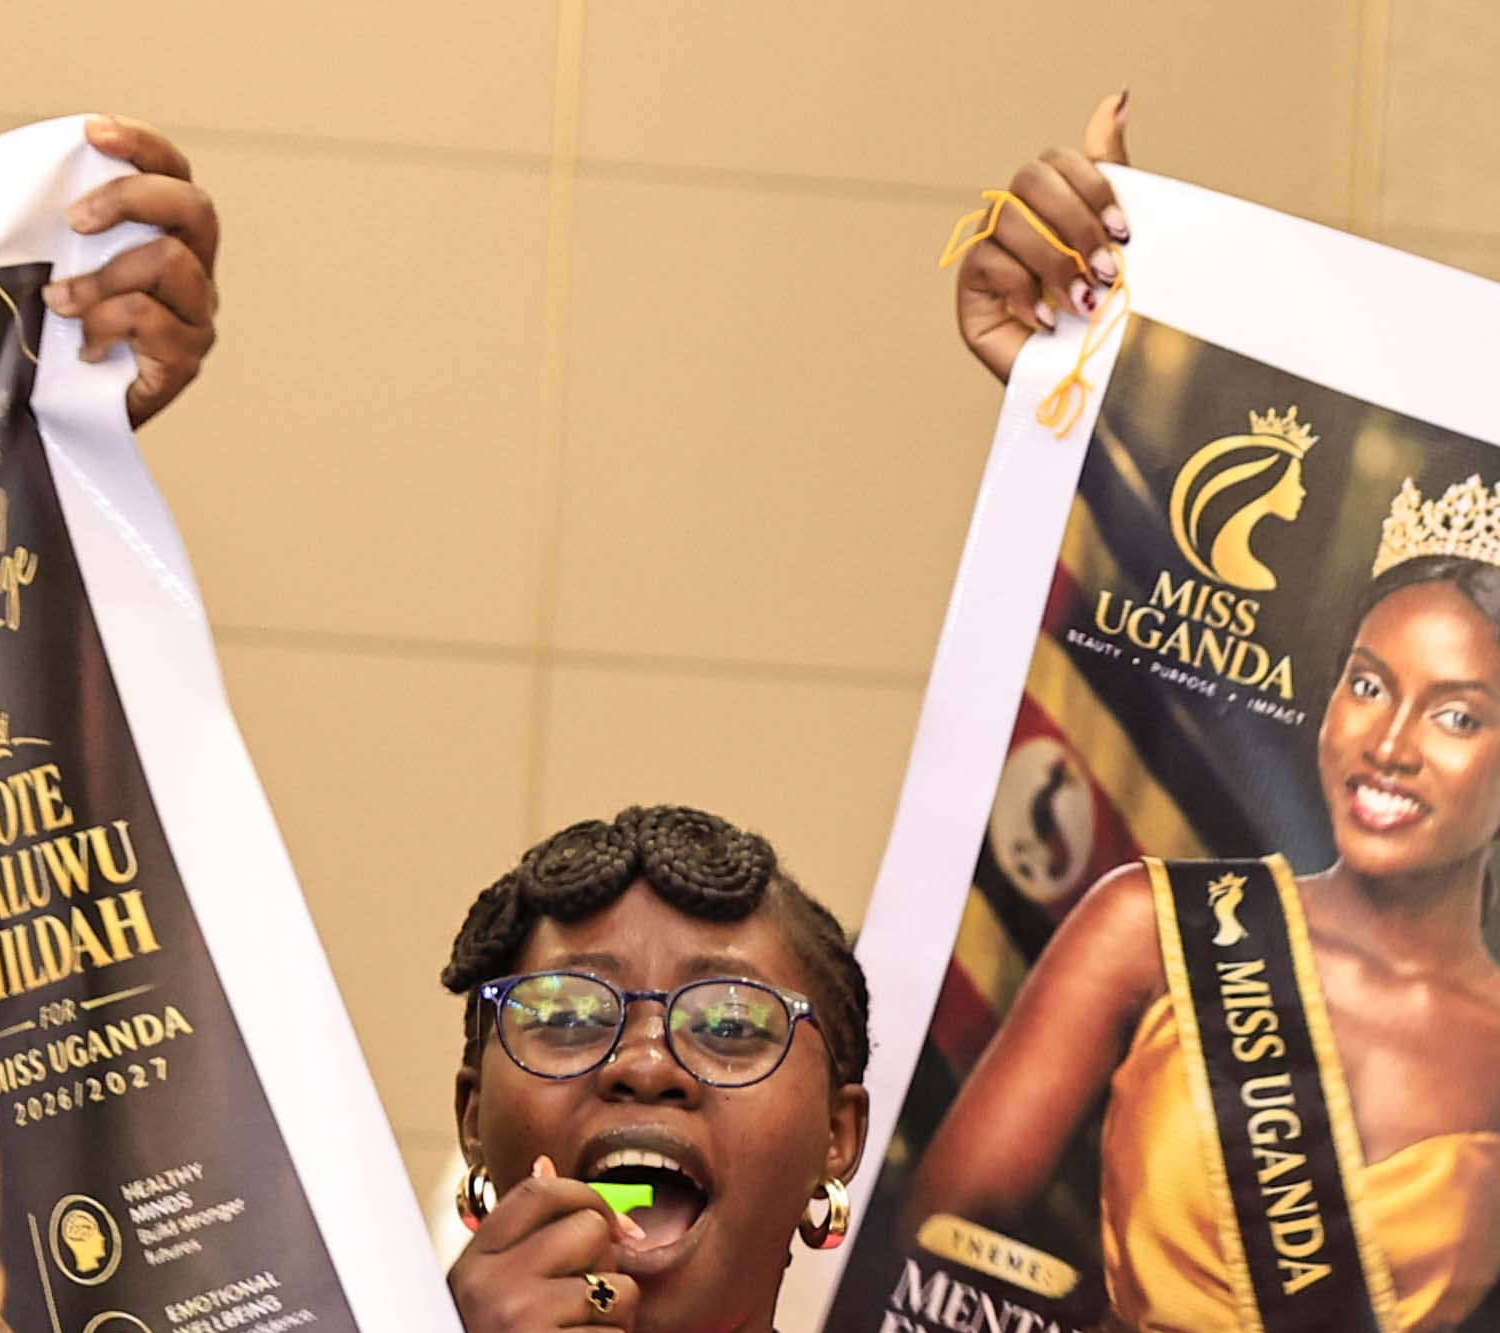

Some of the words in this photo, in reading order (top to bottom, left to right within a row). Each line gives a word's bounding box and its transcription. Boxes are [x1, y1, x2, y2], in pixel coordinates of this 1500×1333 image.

[1094, 589, 1295, 701] UGANDA
[1149, 570, 1261, 637] MISS
[1066, 628, 1122, 659] BEAUTY
[1150, 660, 1219, 697] PURPOSE
[1246, 698, 1306, 726] IMPACT
[39, 998, 78, 1029] FOR
[46, 1006, 193, 1074] UGANDA
[1215, 958, 1286, 1064] MISS
[13, 1056, 168, 1127] 2026/2027
[1240, 1073, 1333, 1296] UGANDA
